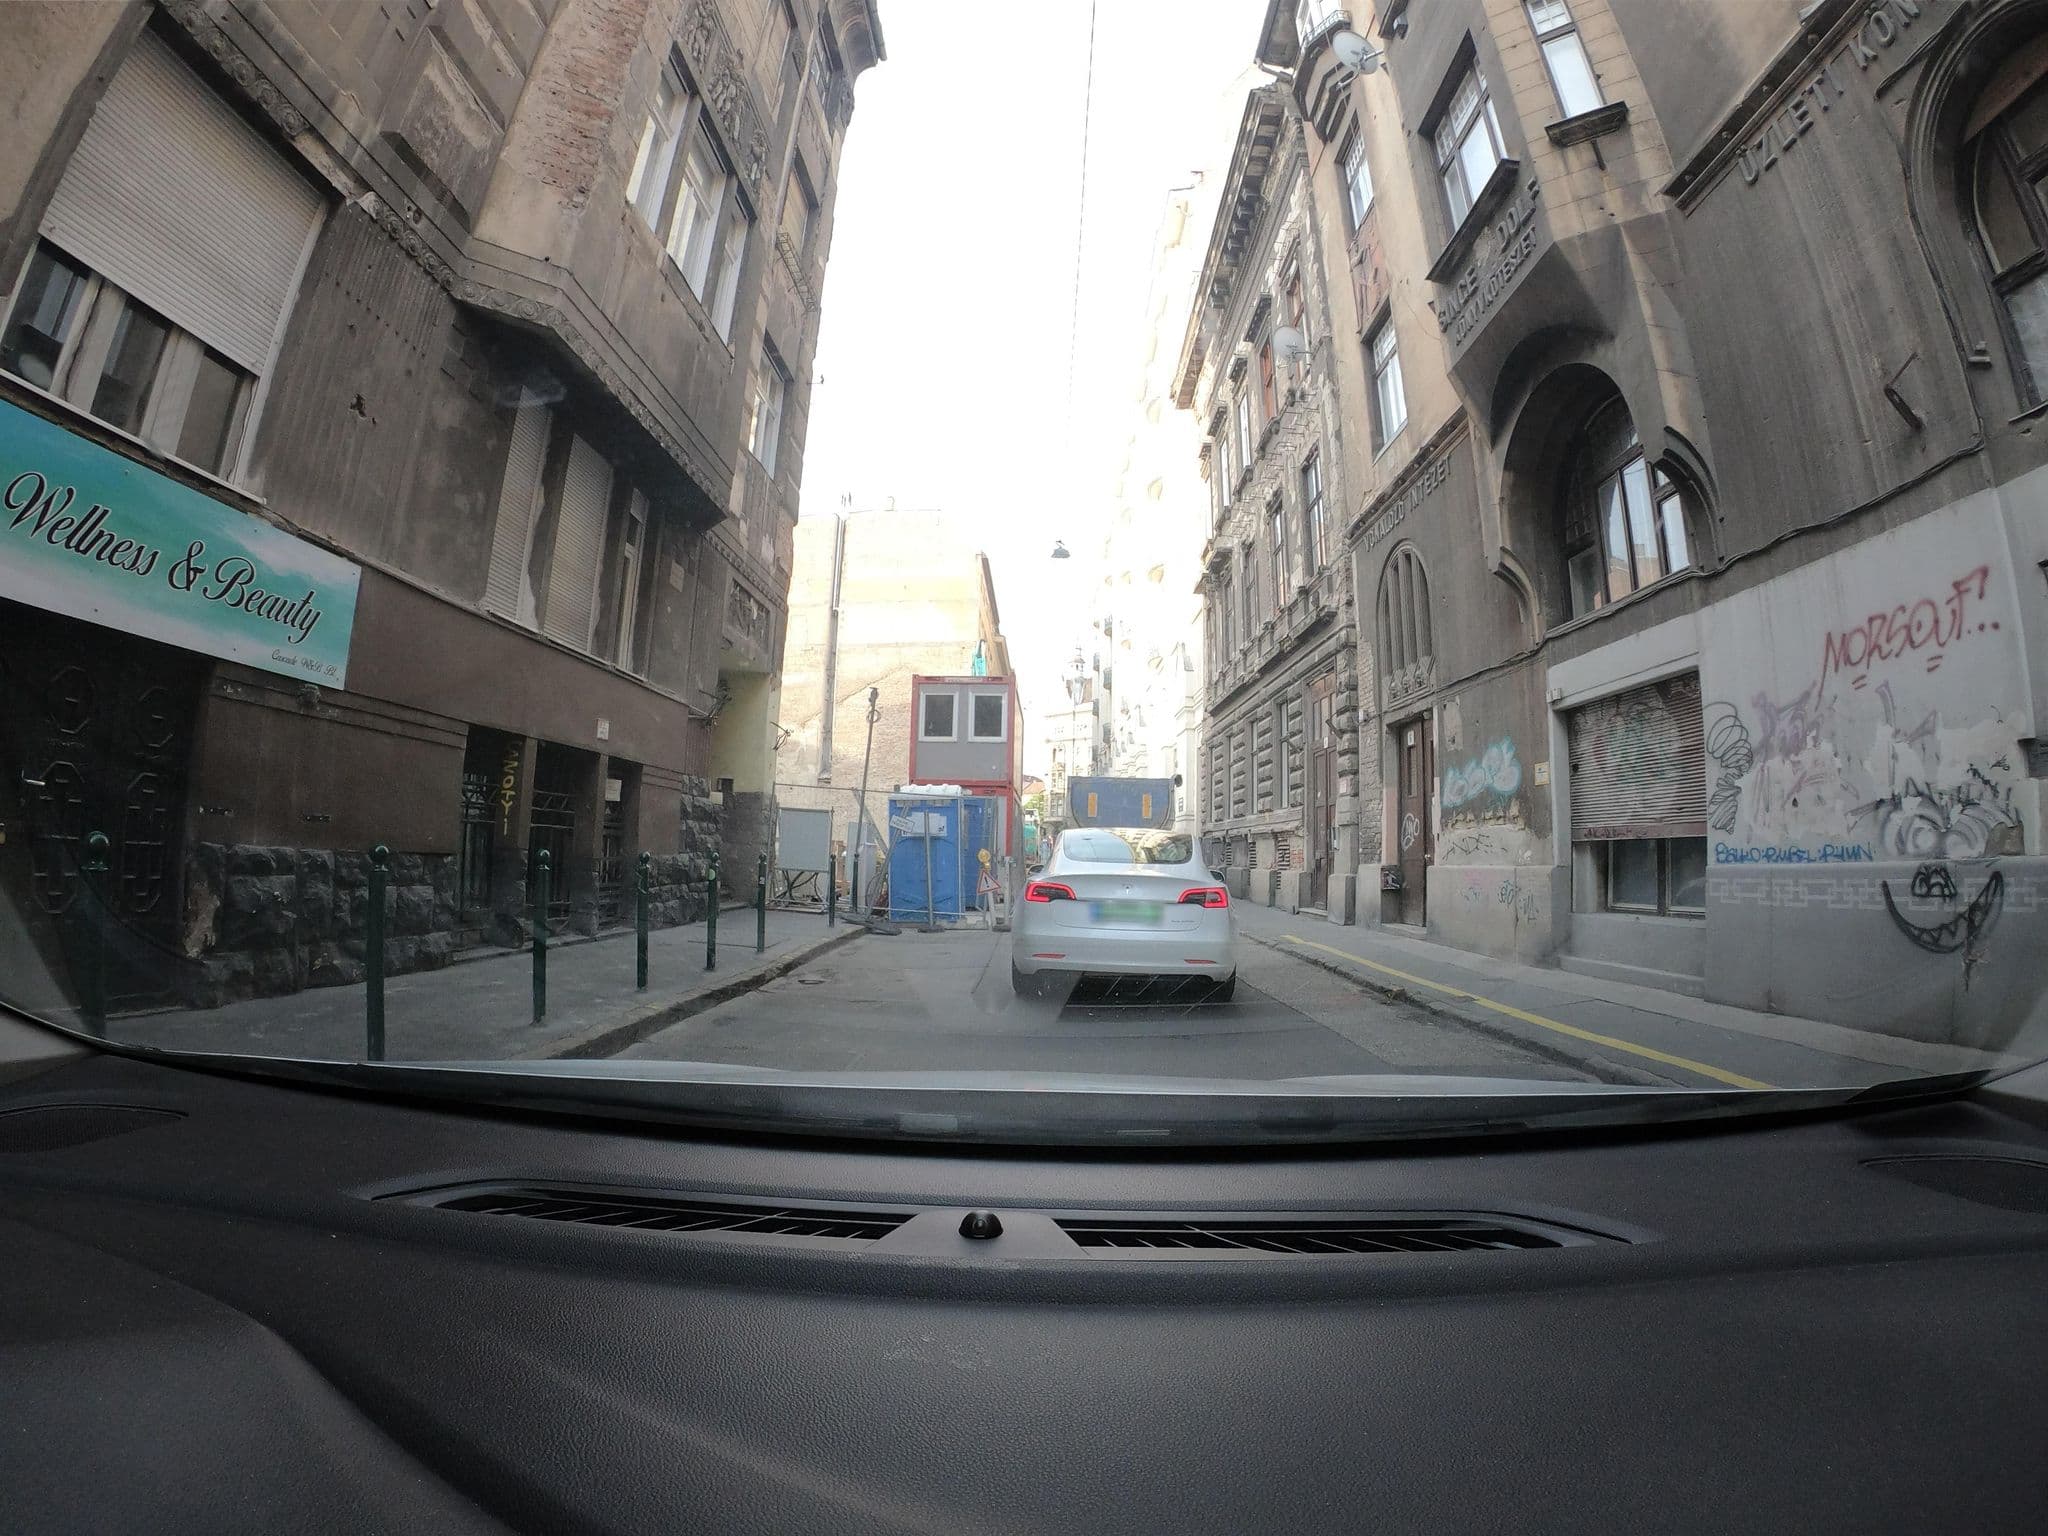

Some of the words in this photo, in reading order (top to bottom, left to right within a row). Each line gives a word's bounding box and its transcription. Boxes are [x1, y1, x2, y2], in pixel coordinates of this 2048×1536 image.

[4, 472, 160, 577] Wellness
[168, 540, 207, 592] &
[202, 557, 322, 645] Beauty
